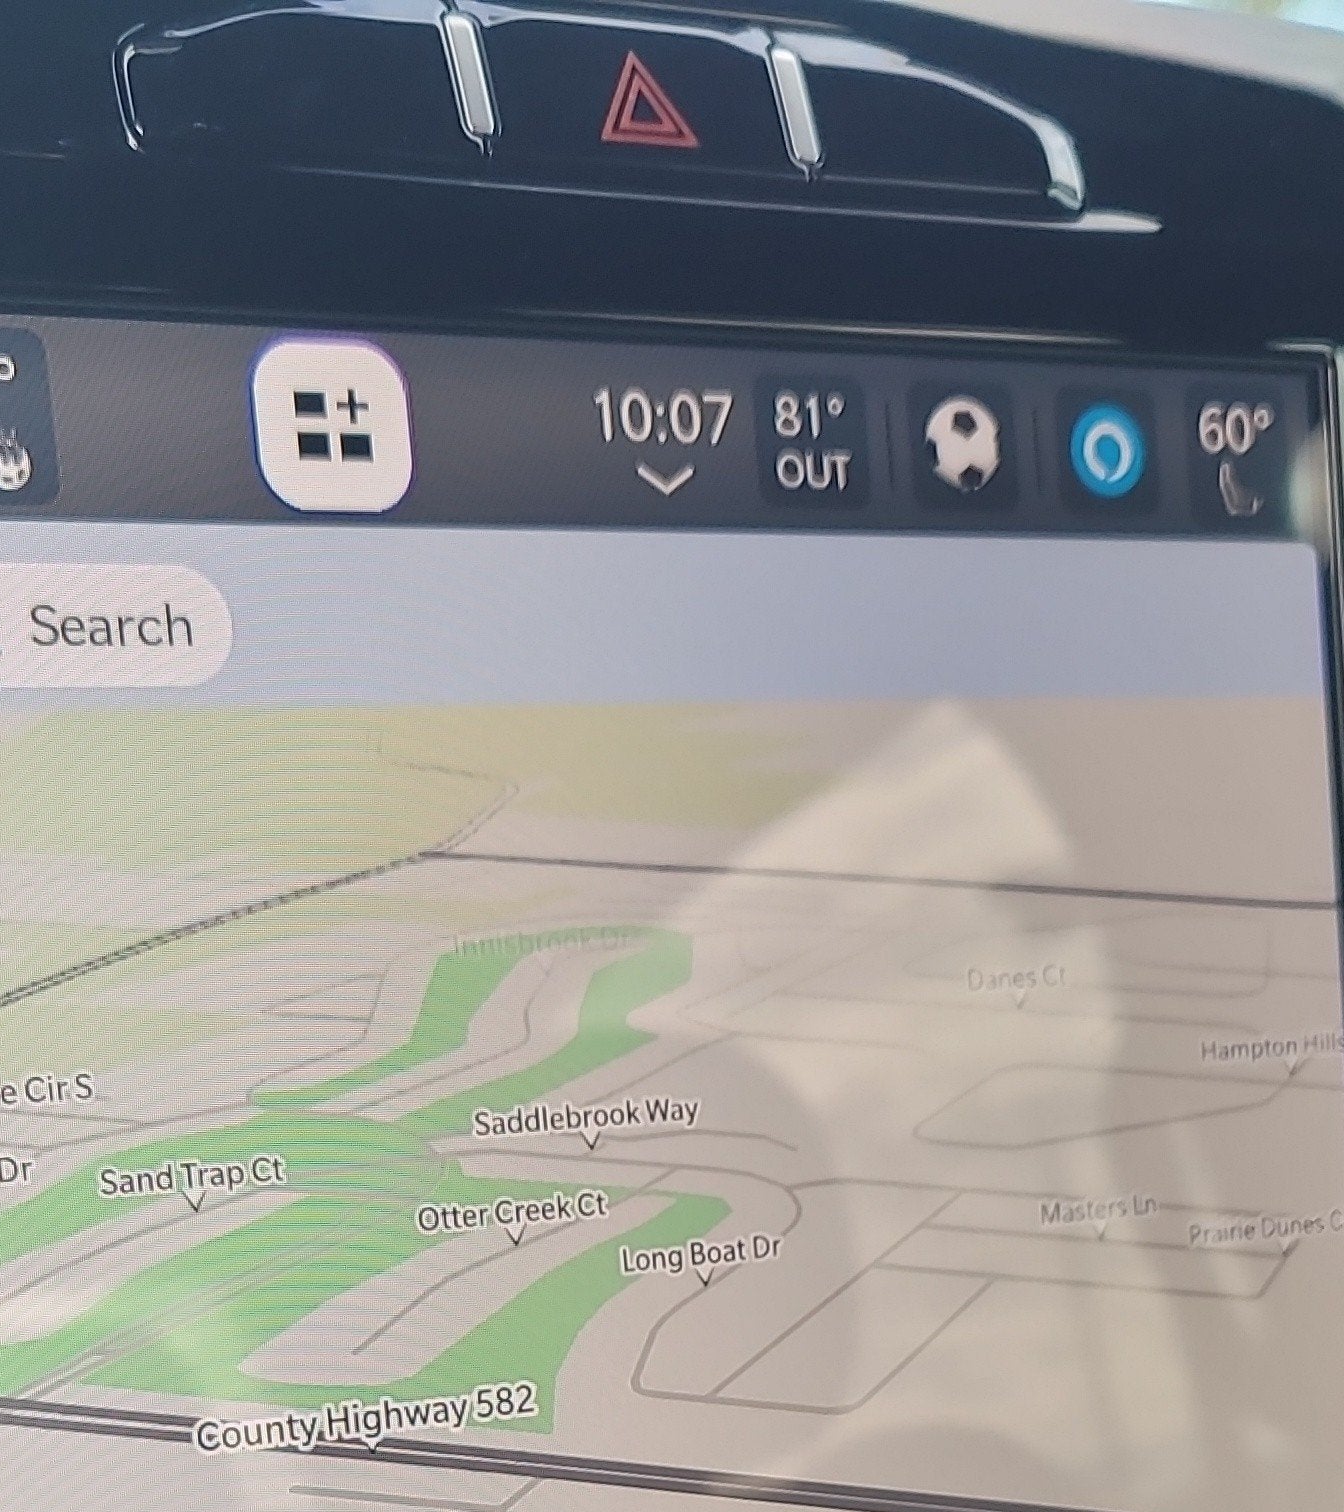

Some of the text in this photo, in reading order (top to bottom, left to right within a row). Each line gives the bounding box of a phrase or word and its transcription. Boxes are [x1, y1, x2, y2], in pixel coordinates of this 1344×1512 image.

[592, 386, 734, 448] 10:07
[773, 388, 846, 441] 81°
[1196, 401, 1275, 456] 60°
[775, 449, 852, 492] OUT
[29, 603, 194, 647] Search
[967, 964, 1067, 991] Danes Ct
[1200, 1035, 1298, 1063] Hampton
[24, 1074, 69, 1103] Cir
[75, 1074, 93, 1100] S
[474, 1098, 698, 1136] Saddlebrook Way
[100, 1156, 284, 1196] Sand Trap Ct
[418, 1192, 607, 1232] Otter Creek Ct
[1040, 1196, 1157, 1226] Masters Ln
[1188, 1223, 1257, 1247] Prairie
[1261, 1216, 1325, 1239] Dunes
[622, 1233, 781, 1274] Long Boat Dr
[196, 1385, 536, 1453] County Highway 582
